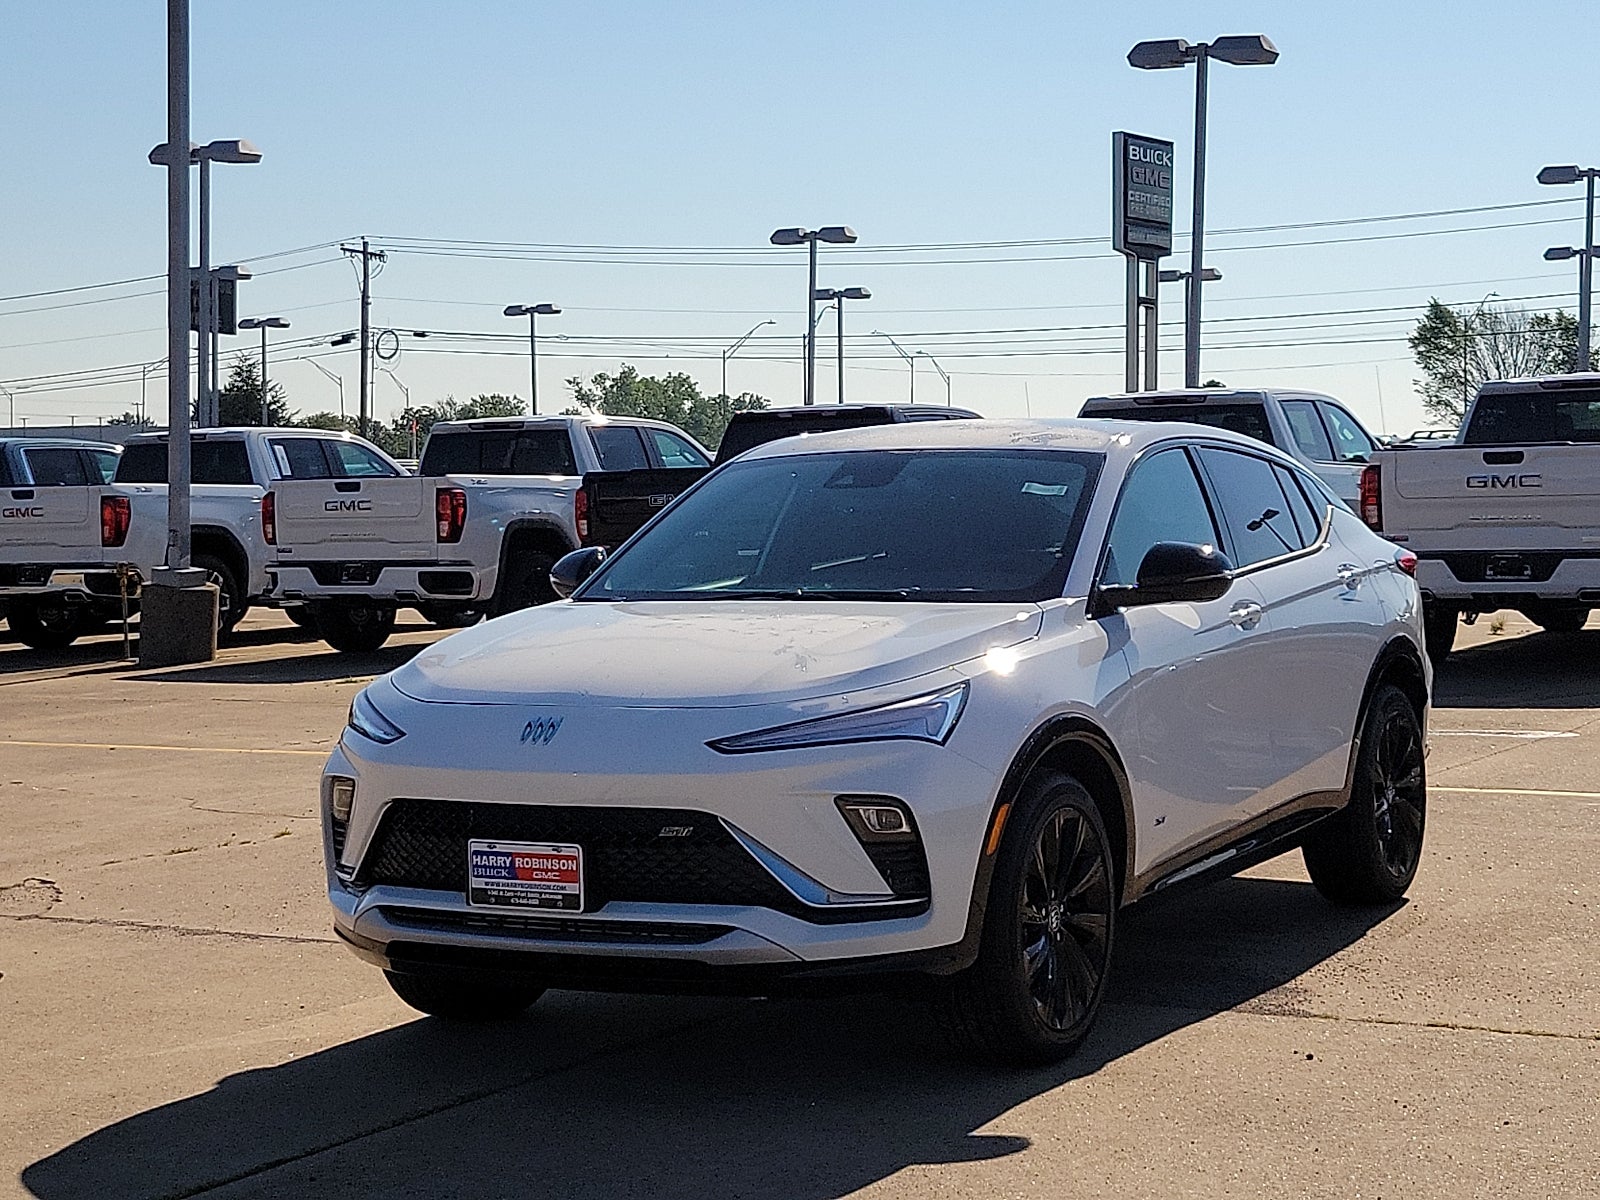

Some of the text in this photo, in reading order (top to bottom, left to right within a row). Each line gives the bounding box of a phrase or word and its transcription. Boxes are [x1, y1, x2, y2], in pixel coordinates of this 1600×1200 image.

[1129, 145, 1172, 167] BUICK
[1131, 166, 1170, 189] GMC
[1466, 474, 1543, 489] GMC
[2, 507, 44, 518] GMC
[324, 500, 372, 512] GMC
[472, 854, 577, 871] HARRY ROBINSON
[473, 867, 561, 880] BUICK GMC
